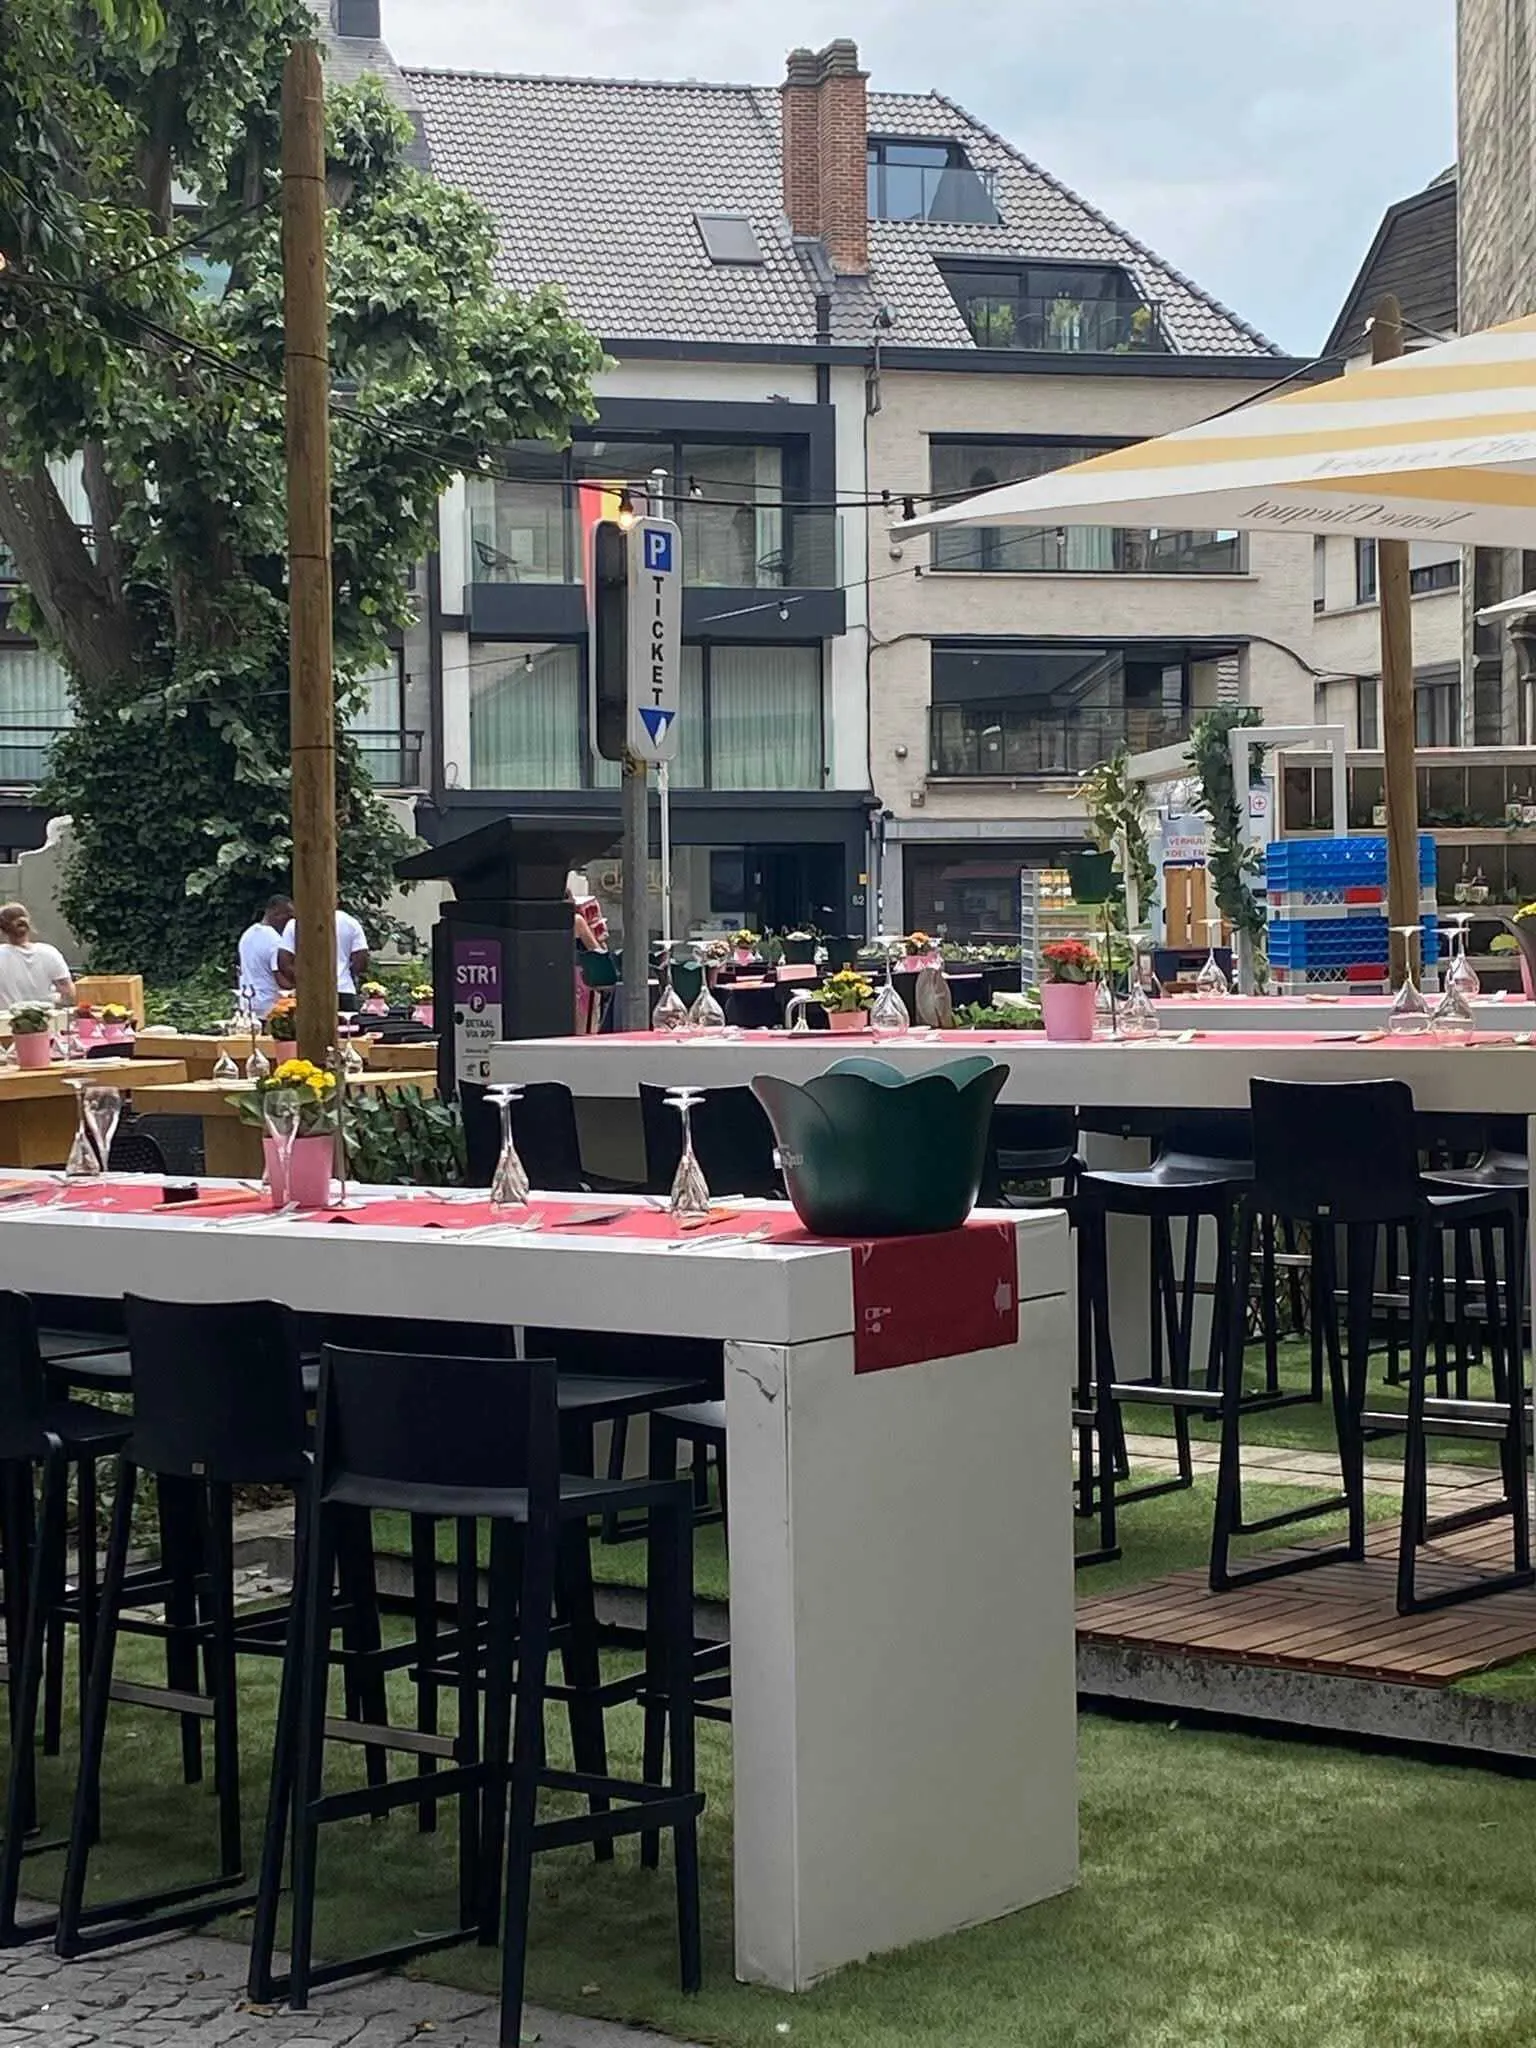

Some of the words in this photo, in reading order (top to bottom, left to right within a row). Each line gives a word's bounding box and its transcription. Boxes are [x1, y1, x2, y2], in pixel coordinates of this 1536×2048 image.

[650, 534, 666, 566] P
[651, 576, 664, 706] TICKET
[456, 965, 497, 984] STR1
[466, 1019, 495, 1028] BETAAL
